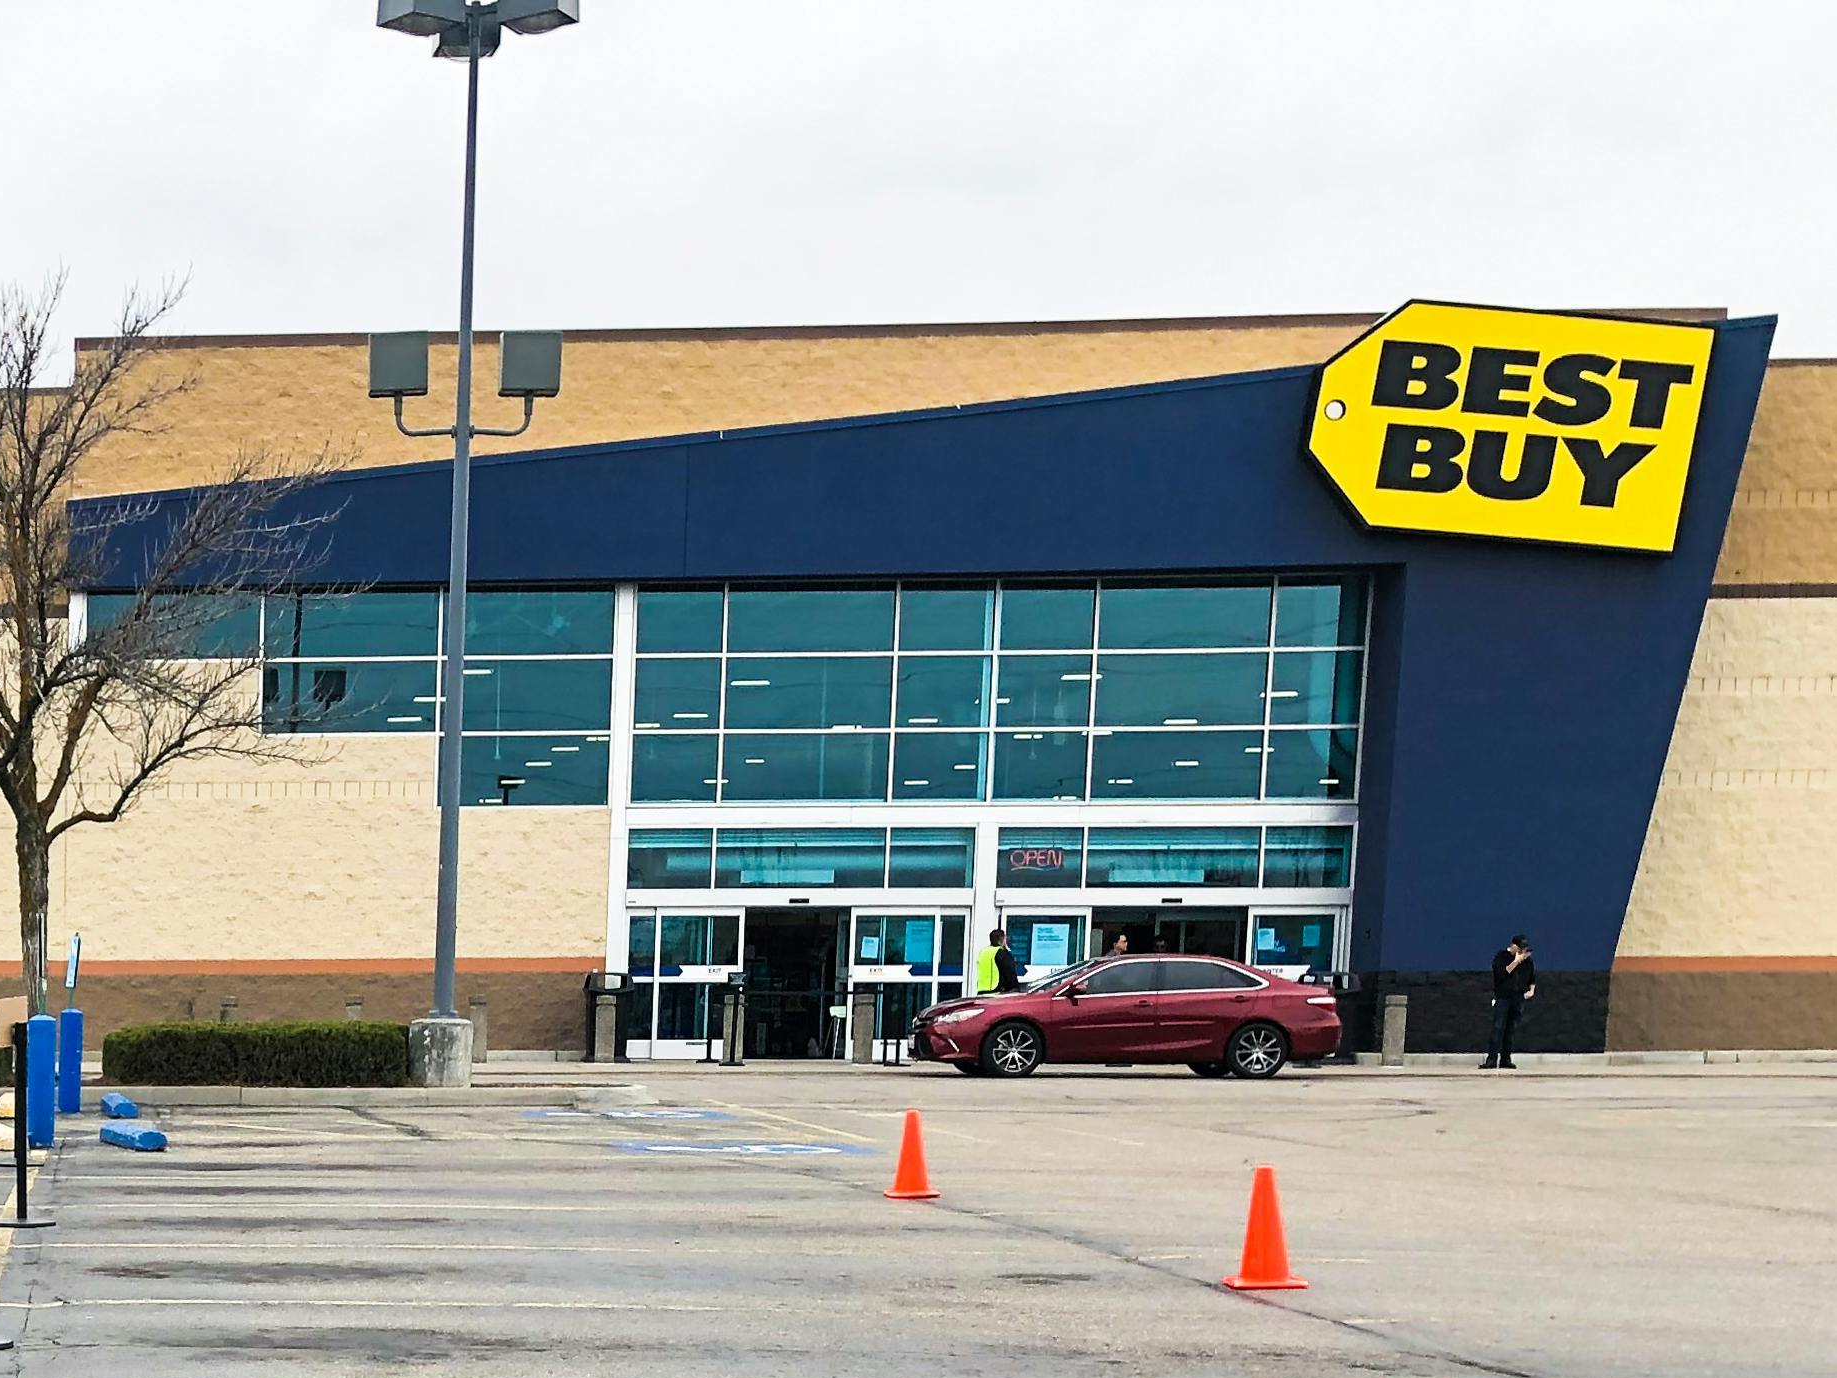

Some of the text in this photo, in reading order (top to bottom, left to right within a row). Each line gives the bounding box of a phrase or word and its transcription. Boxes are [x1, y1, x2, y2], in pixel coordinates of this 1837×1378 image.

[1371, 338, 1695, 430] BEST
[1375, 422, 1658, 508] BUY
[1010, 849, 1062, 867] OPEN
